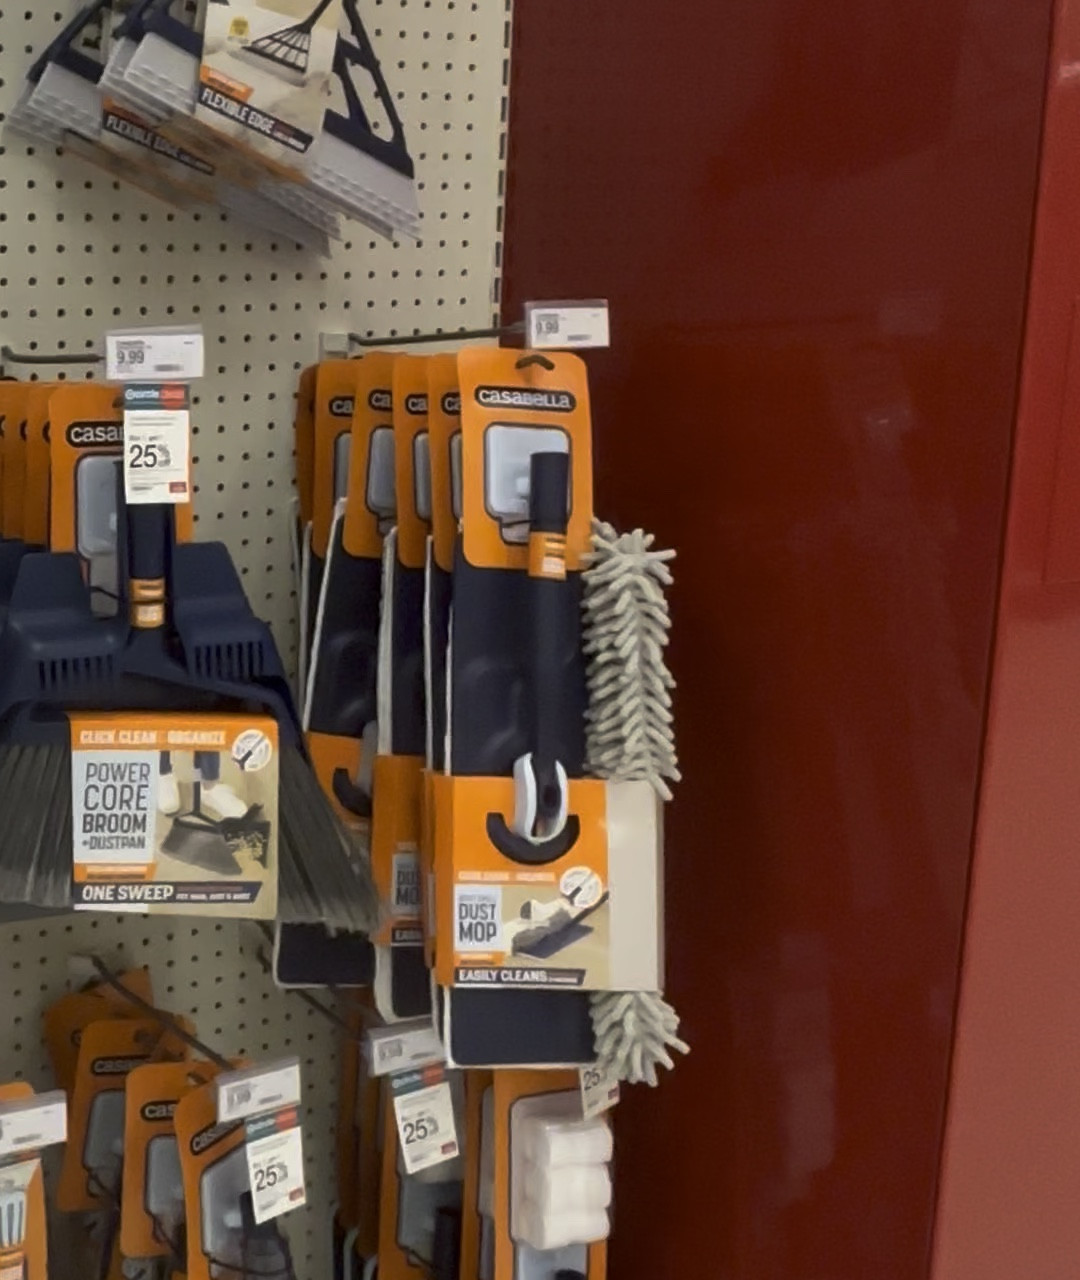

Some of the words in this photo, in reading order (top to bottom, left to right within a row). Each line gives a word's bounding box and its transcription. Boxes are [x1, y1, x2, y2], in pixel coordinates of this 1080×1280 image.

[116, 350, 145, 365] 9.99
[85, 762, 151, 783] POWER
[84, 784, 149, 811] CORE
[82, 813, 148, 834] BROOM
[82, 884, 116, 901] ONE
[117, 884, 174, 901] SWEEP
[459, 903, 497, 920] DUST
[459, 922, 498, 943] MOP
[459, 969, 499, 982] EASILY
